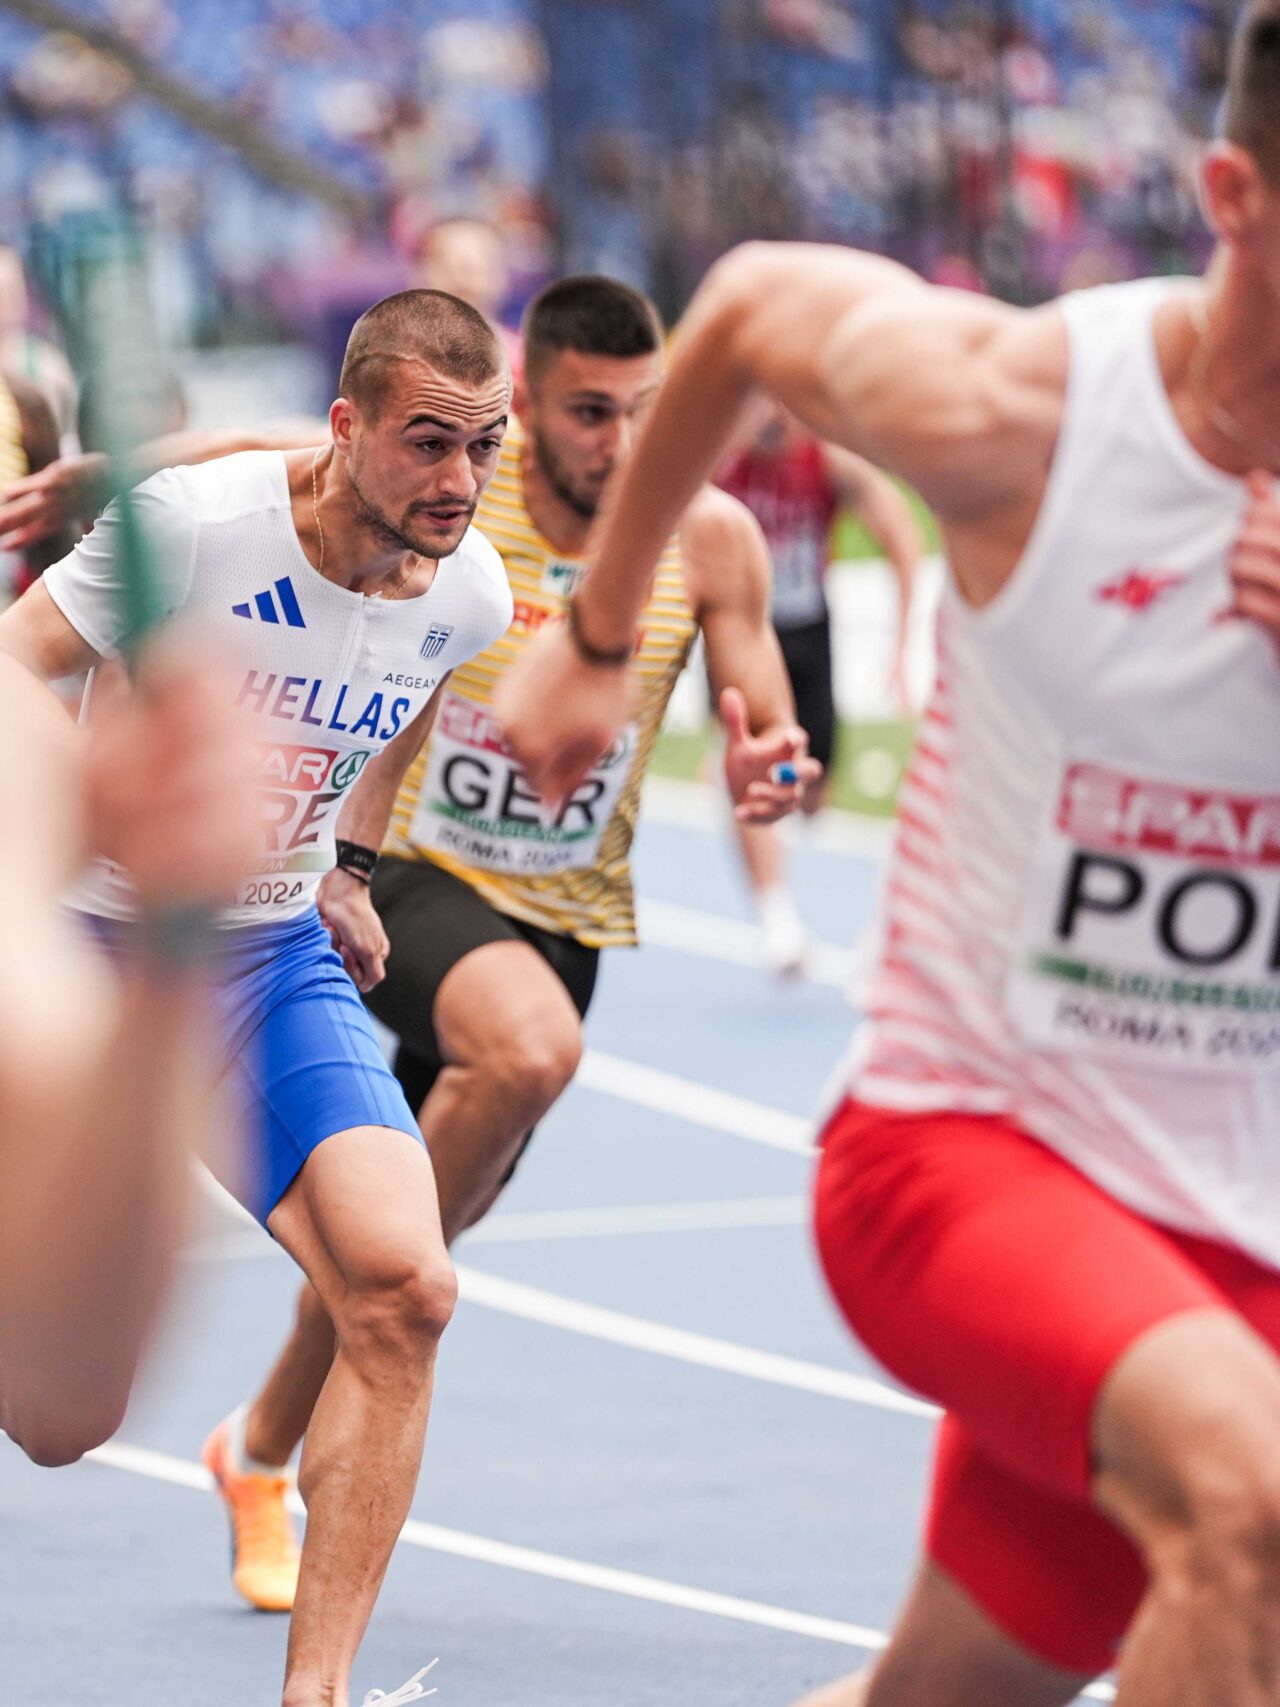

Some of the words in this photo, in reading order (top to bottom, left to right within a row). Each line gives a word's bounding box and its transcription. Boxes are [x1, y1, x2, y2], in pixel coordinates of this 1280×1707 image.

[232, 669, 410, 741] HELLAS
[382, 672, 438, 689] AEGEAN
[256, 790, 345, 851] RE
[442, 754, 605, 828] GER
[244, 881, 303, 905] 2024
